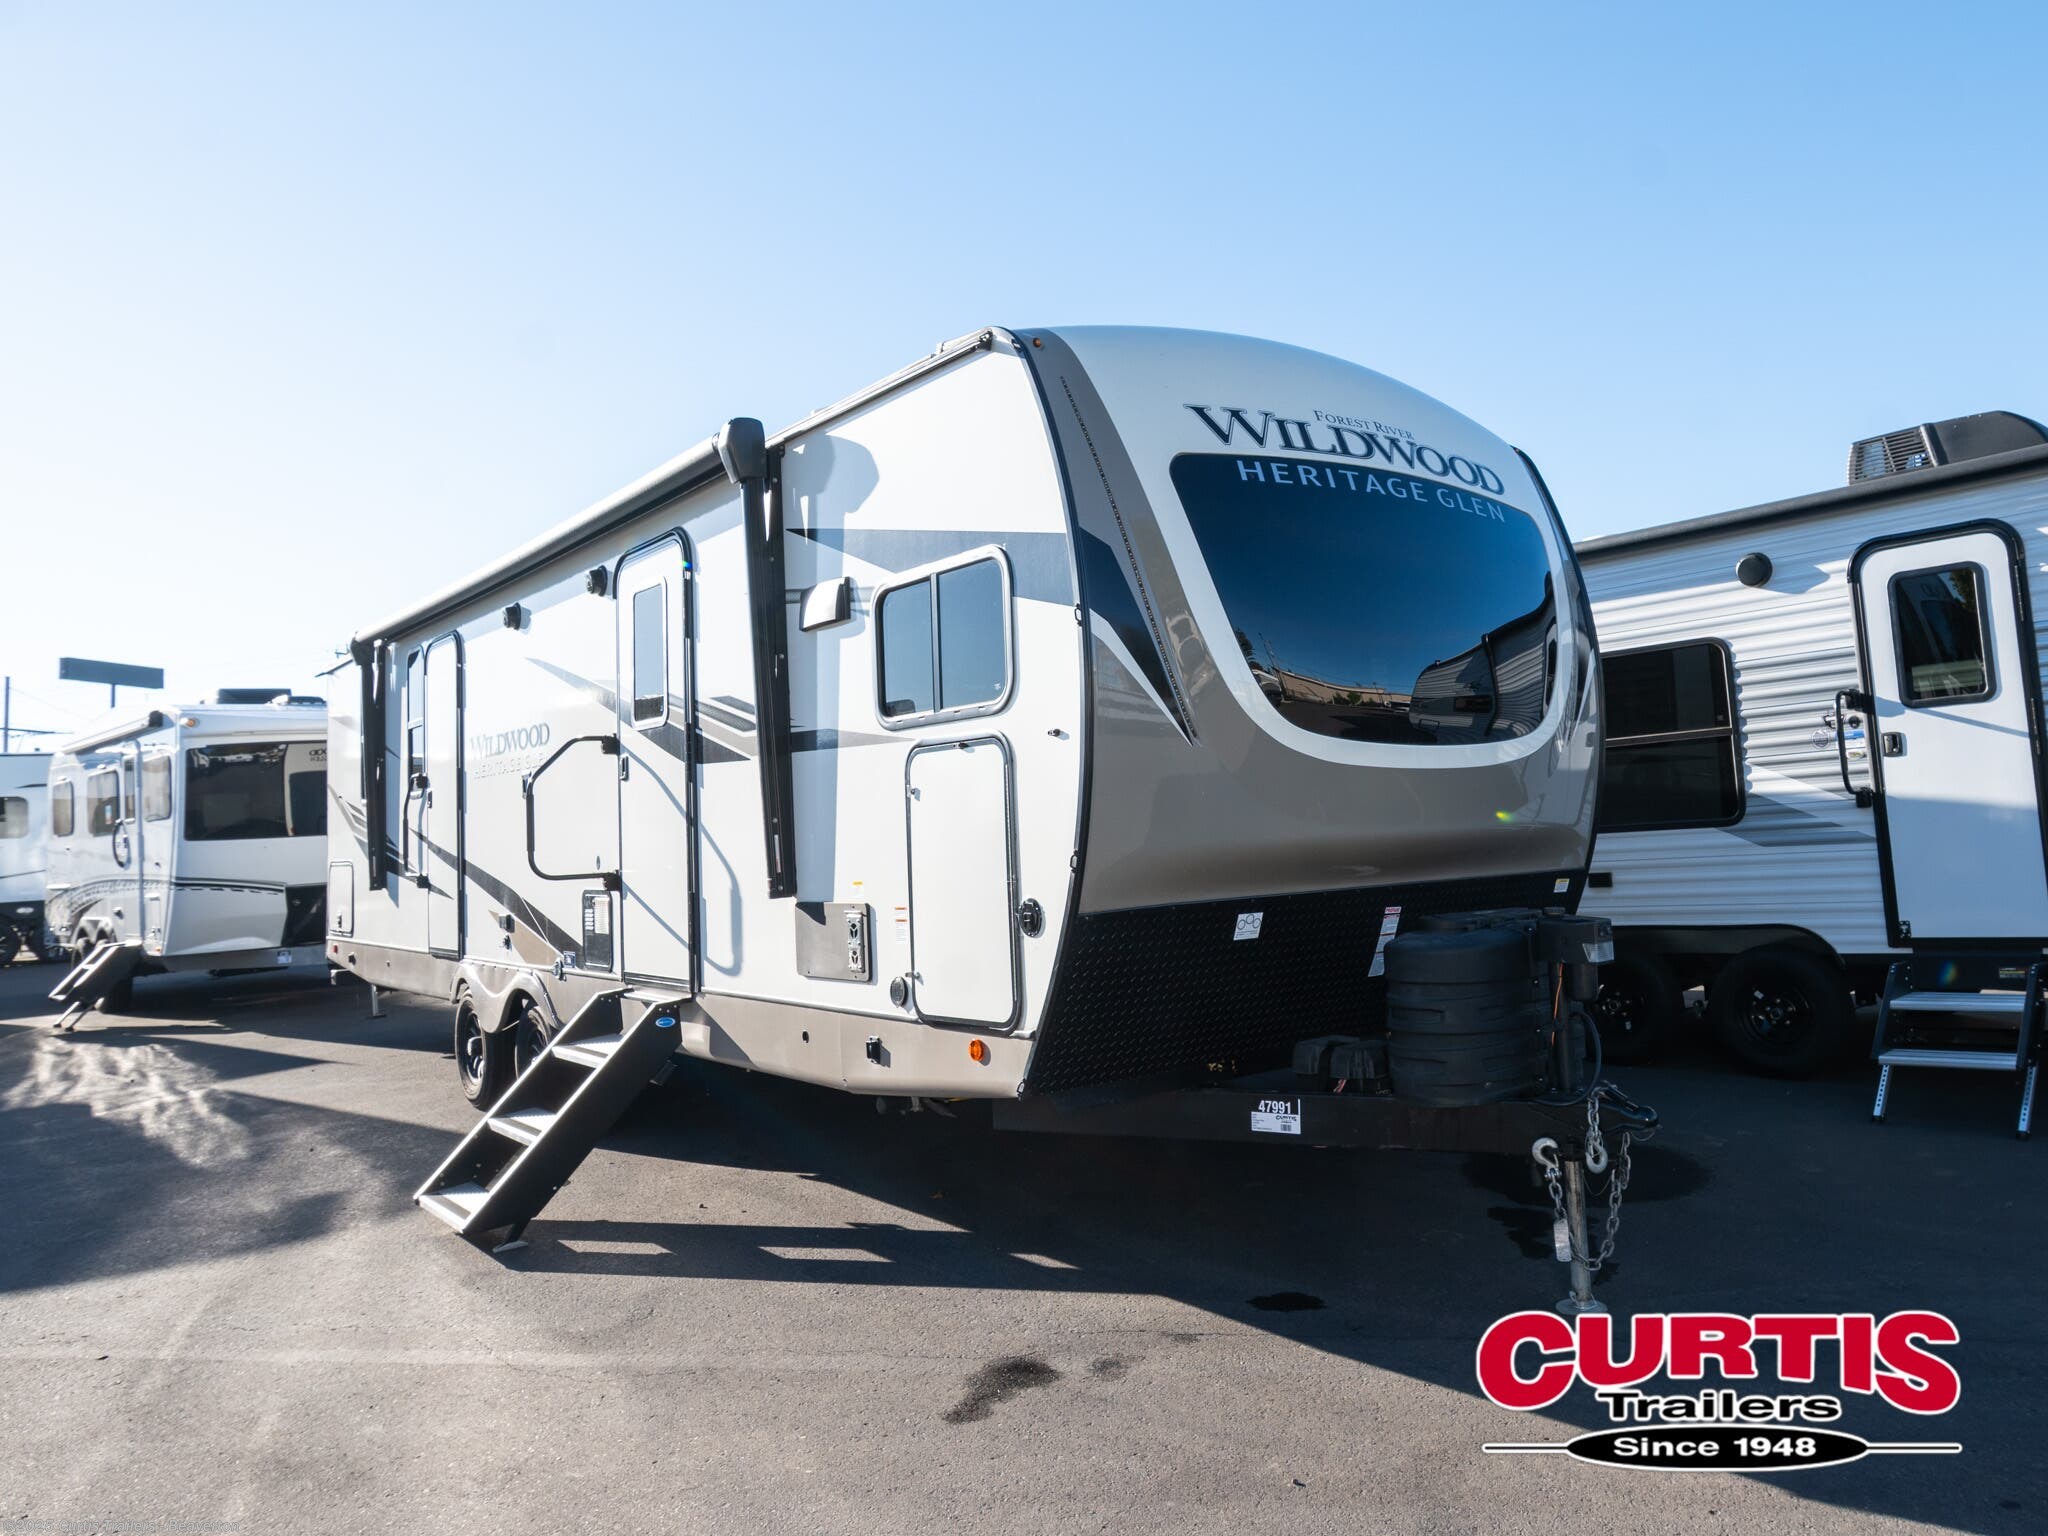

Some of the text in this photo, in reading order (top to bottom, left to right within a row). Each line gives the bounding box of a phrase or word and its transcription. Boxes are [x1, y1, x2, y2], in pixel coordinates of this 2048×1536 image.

[1183, 403, 1505, 495] WILDWOOD
[1236, 460, 1506, 523] HERITAGE GLEN
[470, 722, 550, 759] WILDWOOD
[1258, 1100, 1291, 1114] 47991
